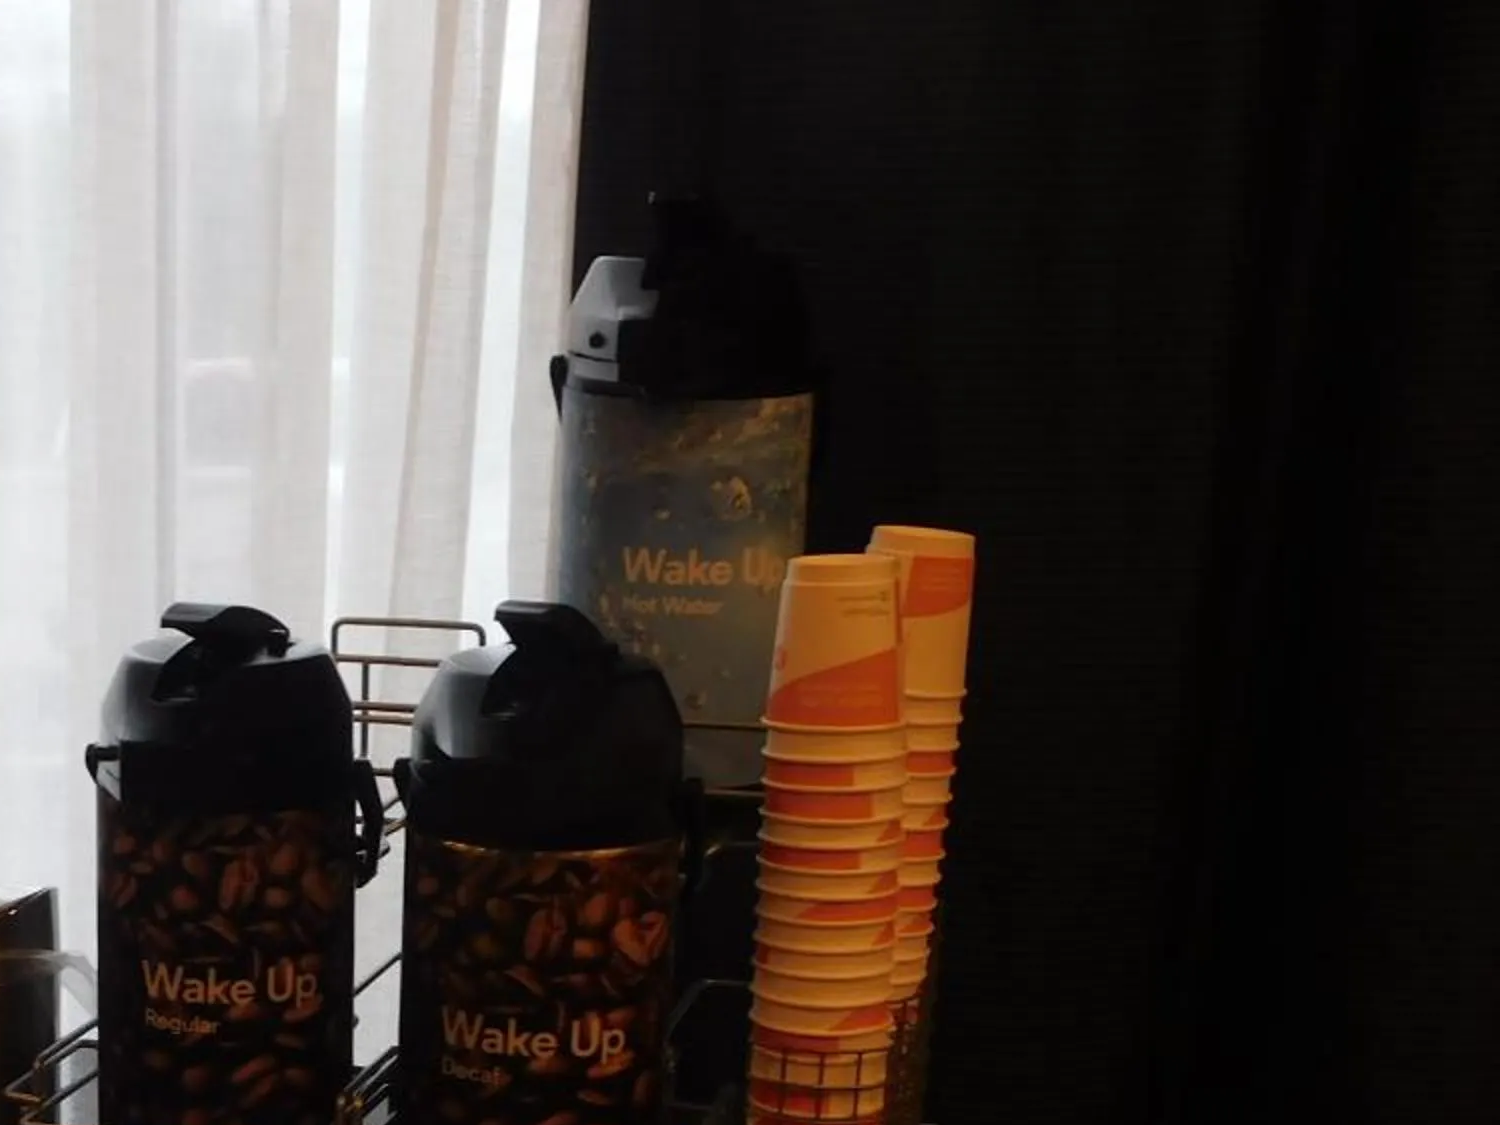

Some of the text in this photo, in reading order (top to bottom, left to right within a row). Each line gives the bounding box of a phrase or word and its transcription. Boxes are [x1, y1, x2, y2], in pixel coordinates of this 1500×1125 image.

[622, 545, 735, 587] Wake
[141, 958, 318, 1008] Wake Up
[144, 1005, 221, 1036] Regular
[441, 1003, 627, 1065] Wake Up
[441, 1053, 503, 1087] Decaf
